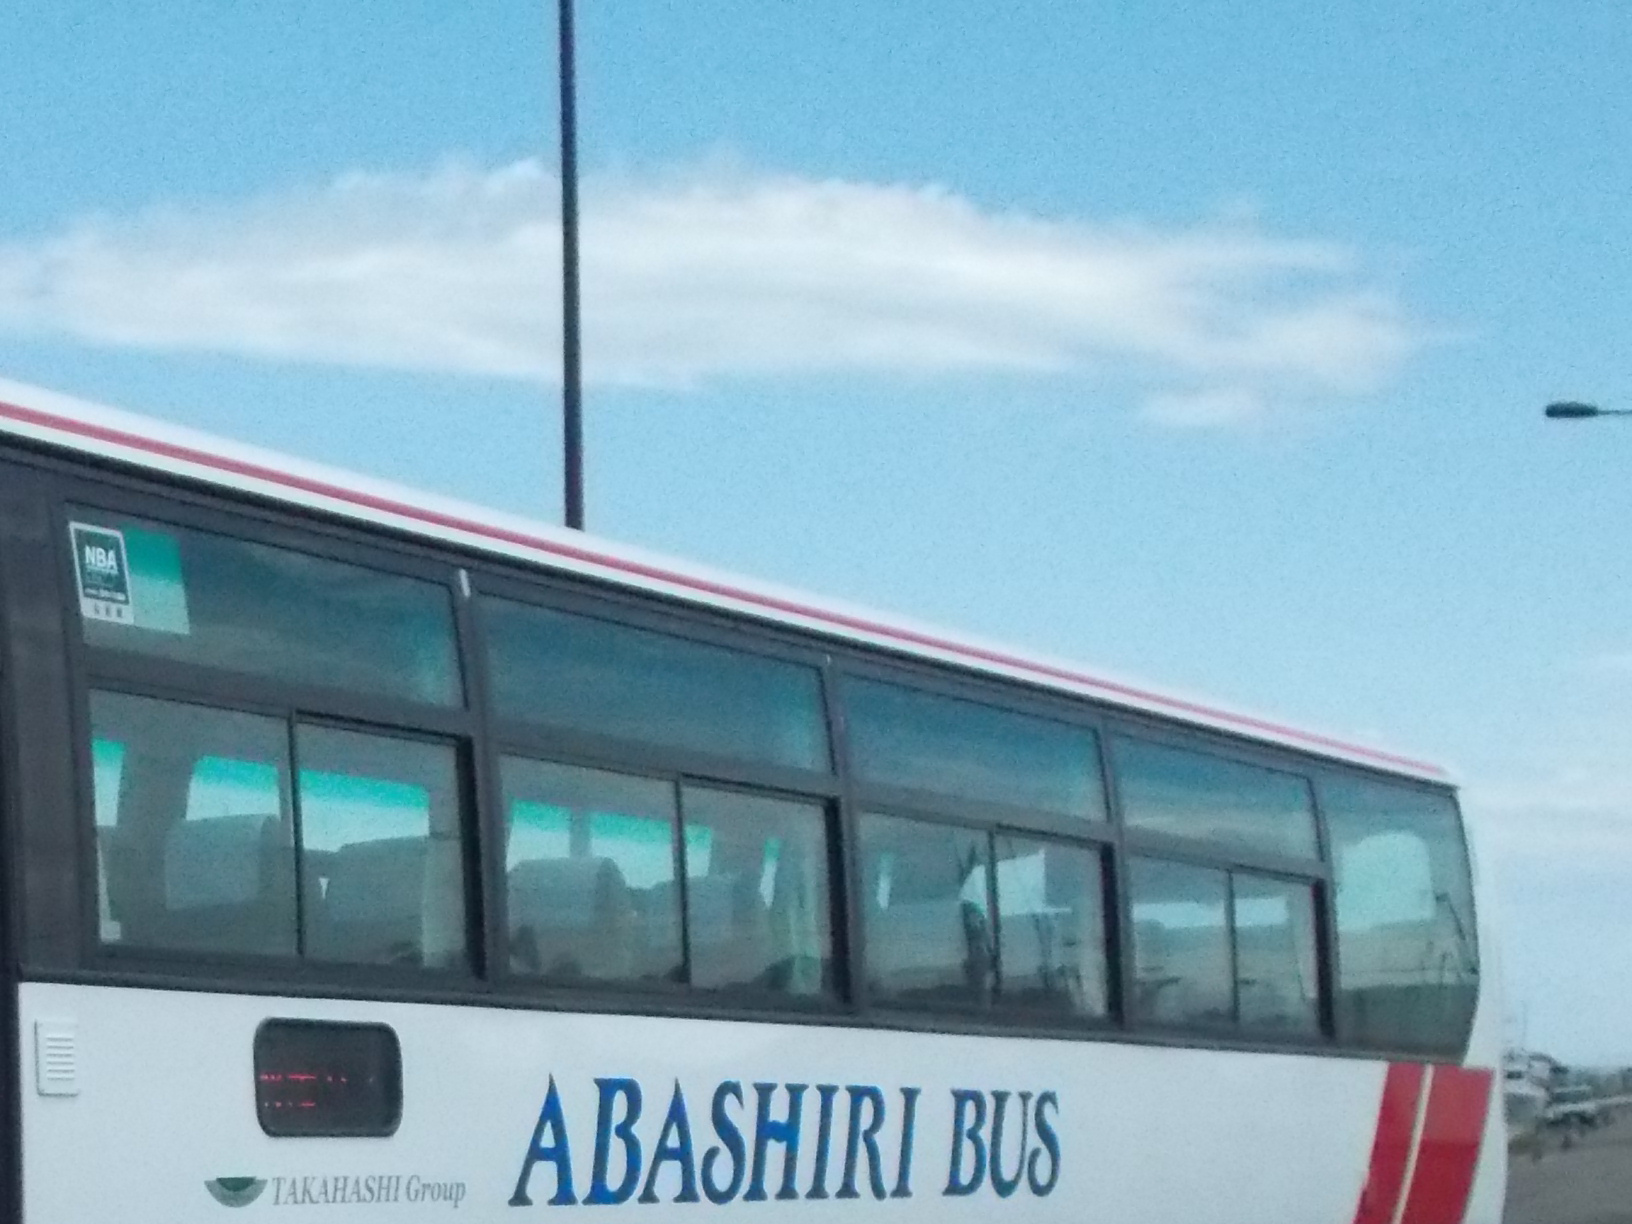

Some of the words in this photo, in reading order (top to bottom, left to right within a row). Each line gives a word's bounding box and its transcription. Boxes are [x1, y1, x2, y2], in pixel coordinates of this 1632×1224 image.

[85, 545, 117, 571] NBA
[507, 1073, 921, 1207] ABASHIRI
[942, 1088, 1062, 1199] BUS
[272, 1175, 402, 1205] TAKAHASHI
[405, 1174, 467, 1209] Group
